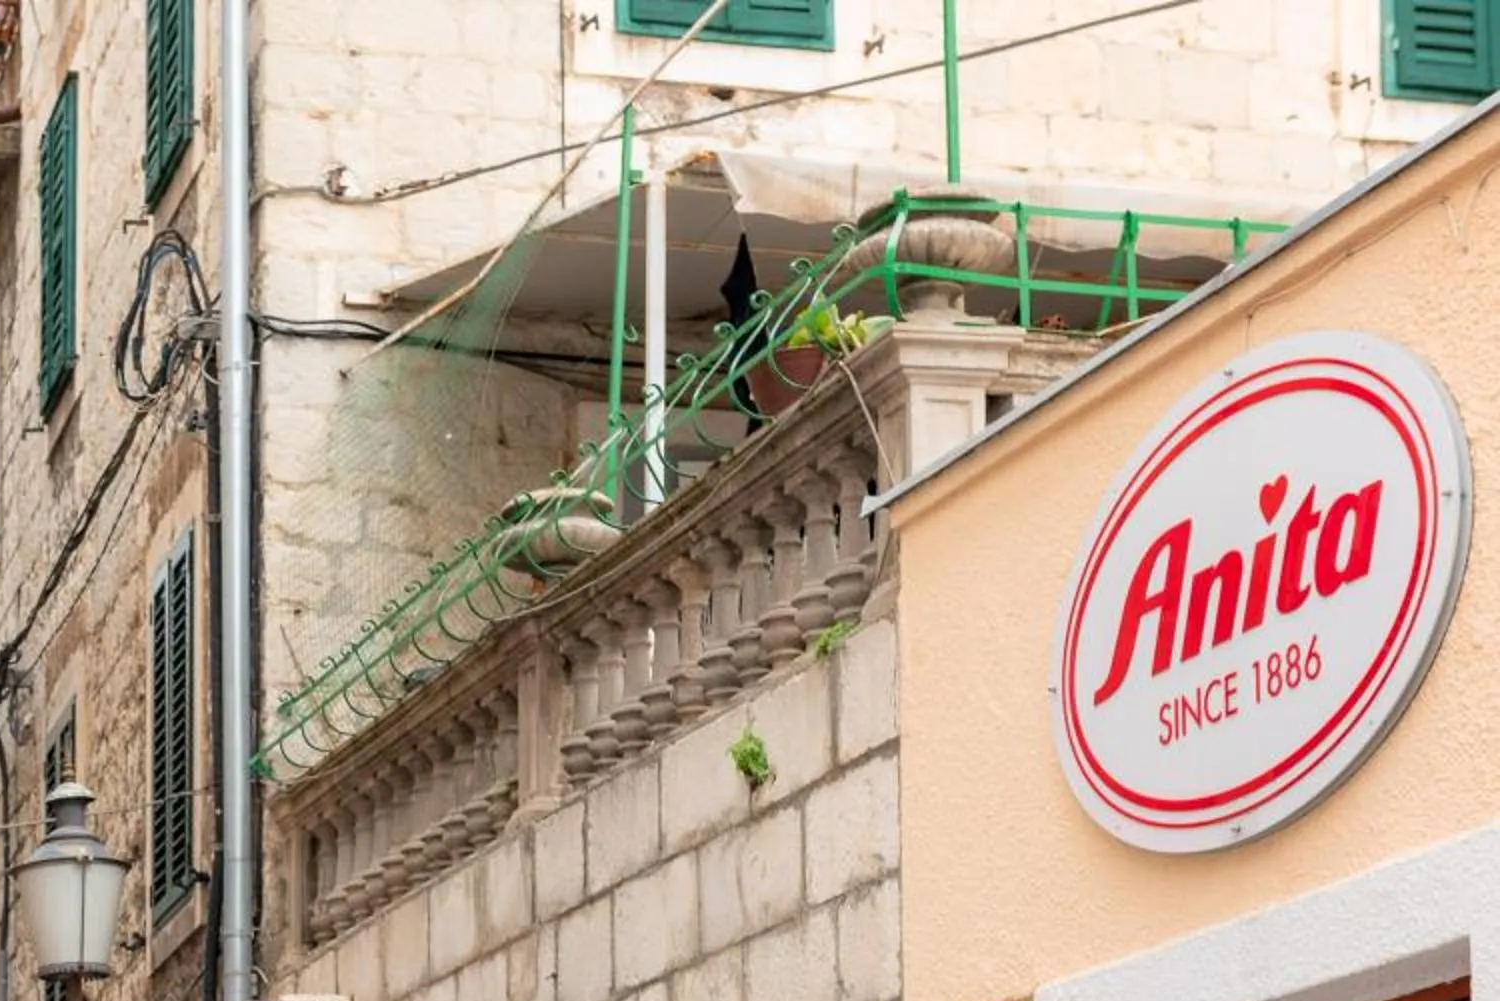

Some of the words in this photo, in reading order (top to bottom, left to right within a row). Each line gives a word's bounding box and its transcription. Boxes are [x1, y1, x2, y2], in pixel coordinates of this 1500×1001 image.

[1092, 474, 1384, 707] Anita
[1157, 670, 1240, 748] SINCE
[1252, 634, 1323, 705] 1886
